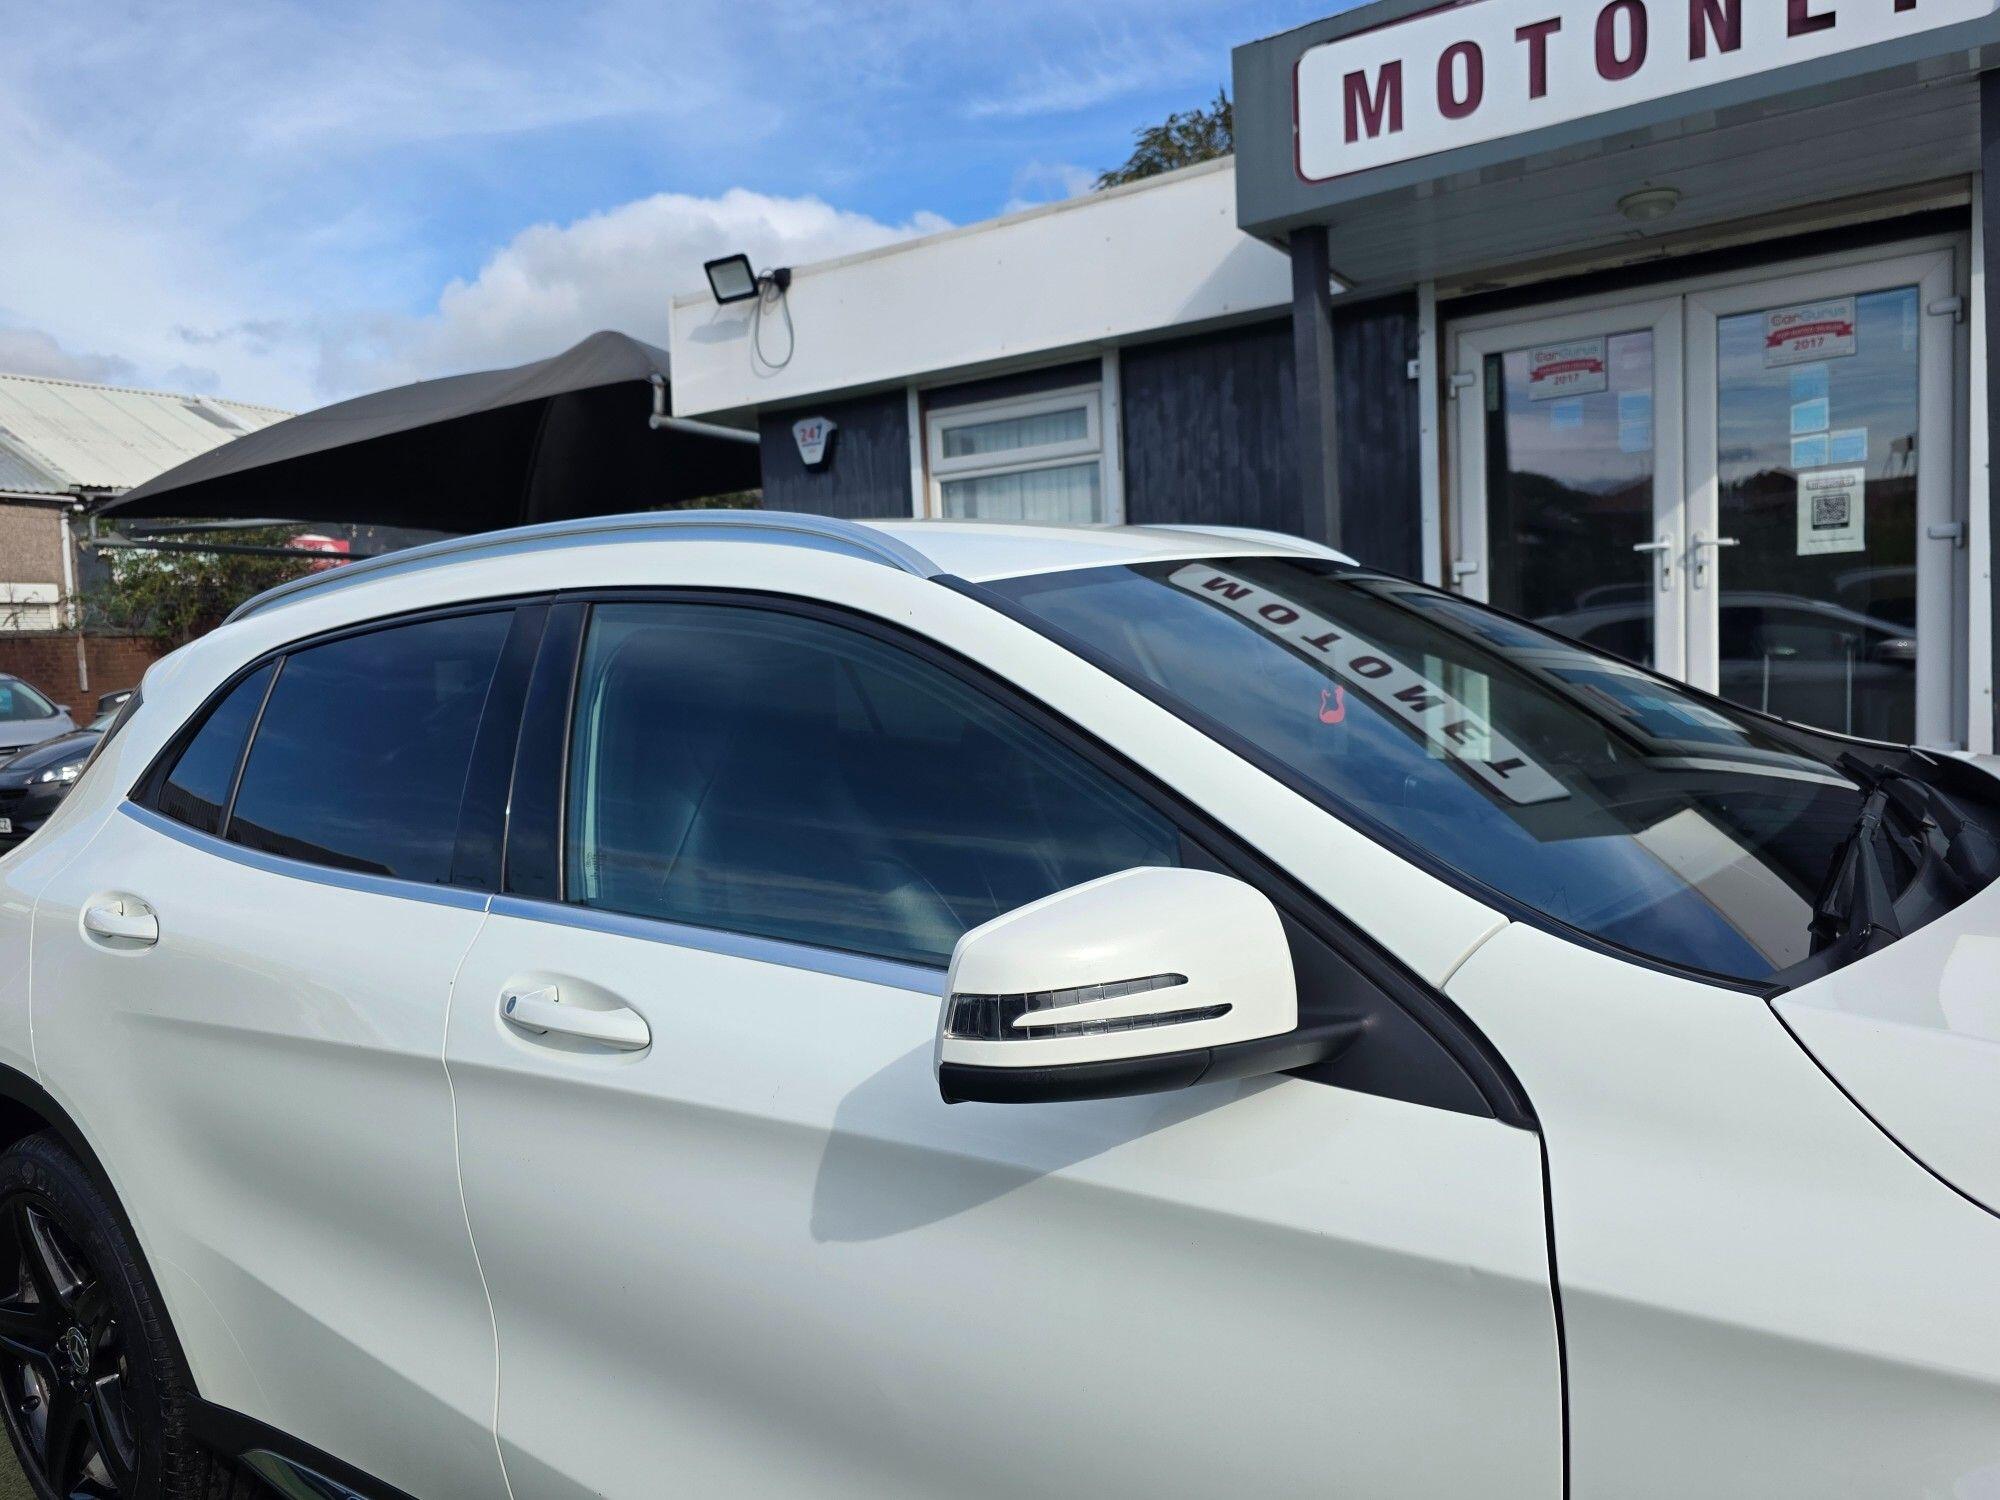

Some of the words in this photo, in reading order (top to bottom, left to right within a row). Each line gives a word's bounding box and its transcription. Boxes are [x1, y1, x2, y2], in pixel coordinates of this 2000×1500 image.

[1344, 0, 1917, 144] MOTON
[1793, 336, 1825, 351] 2017
[800, 422, 823, 442] 247
